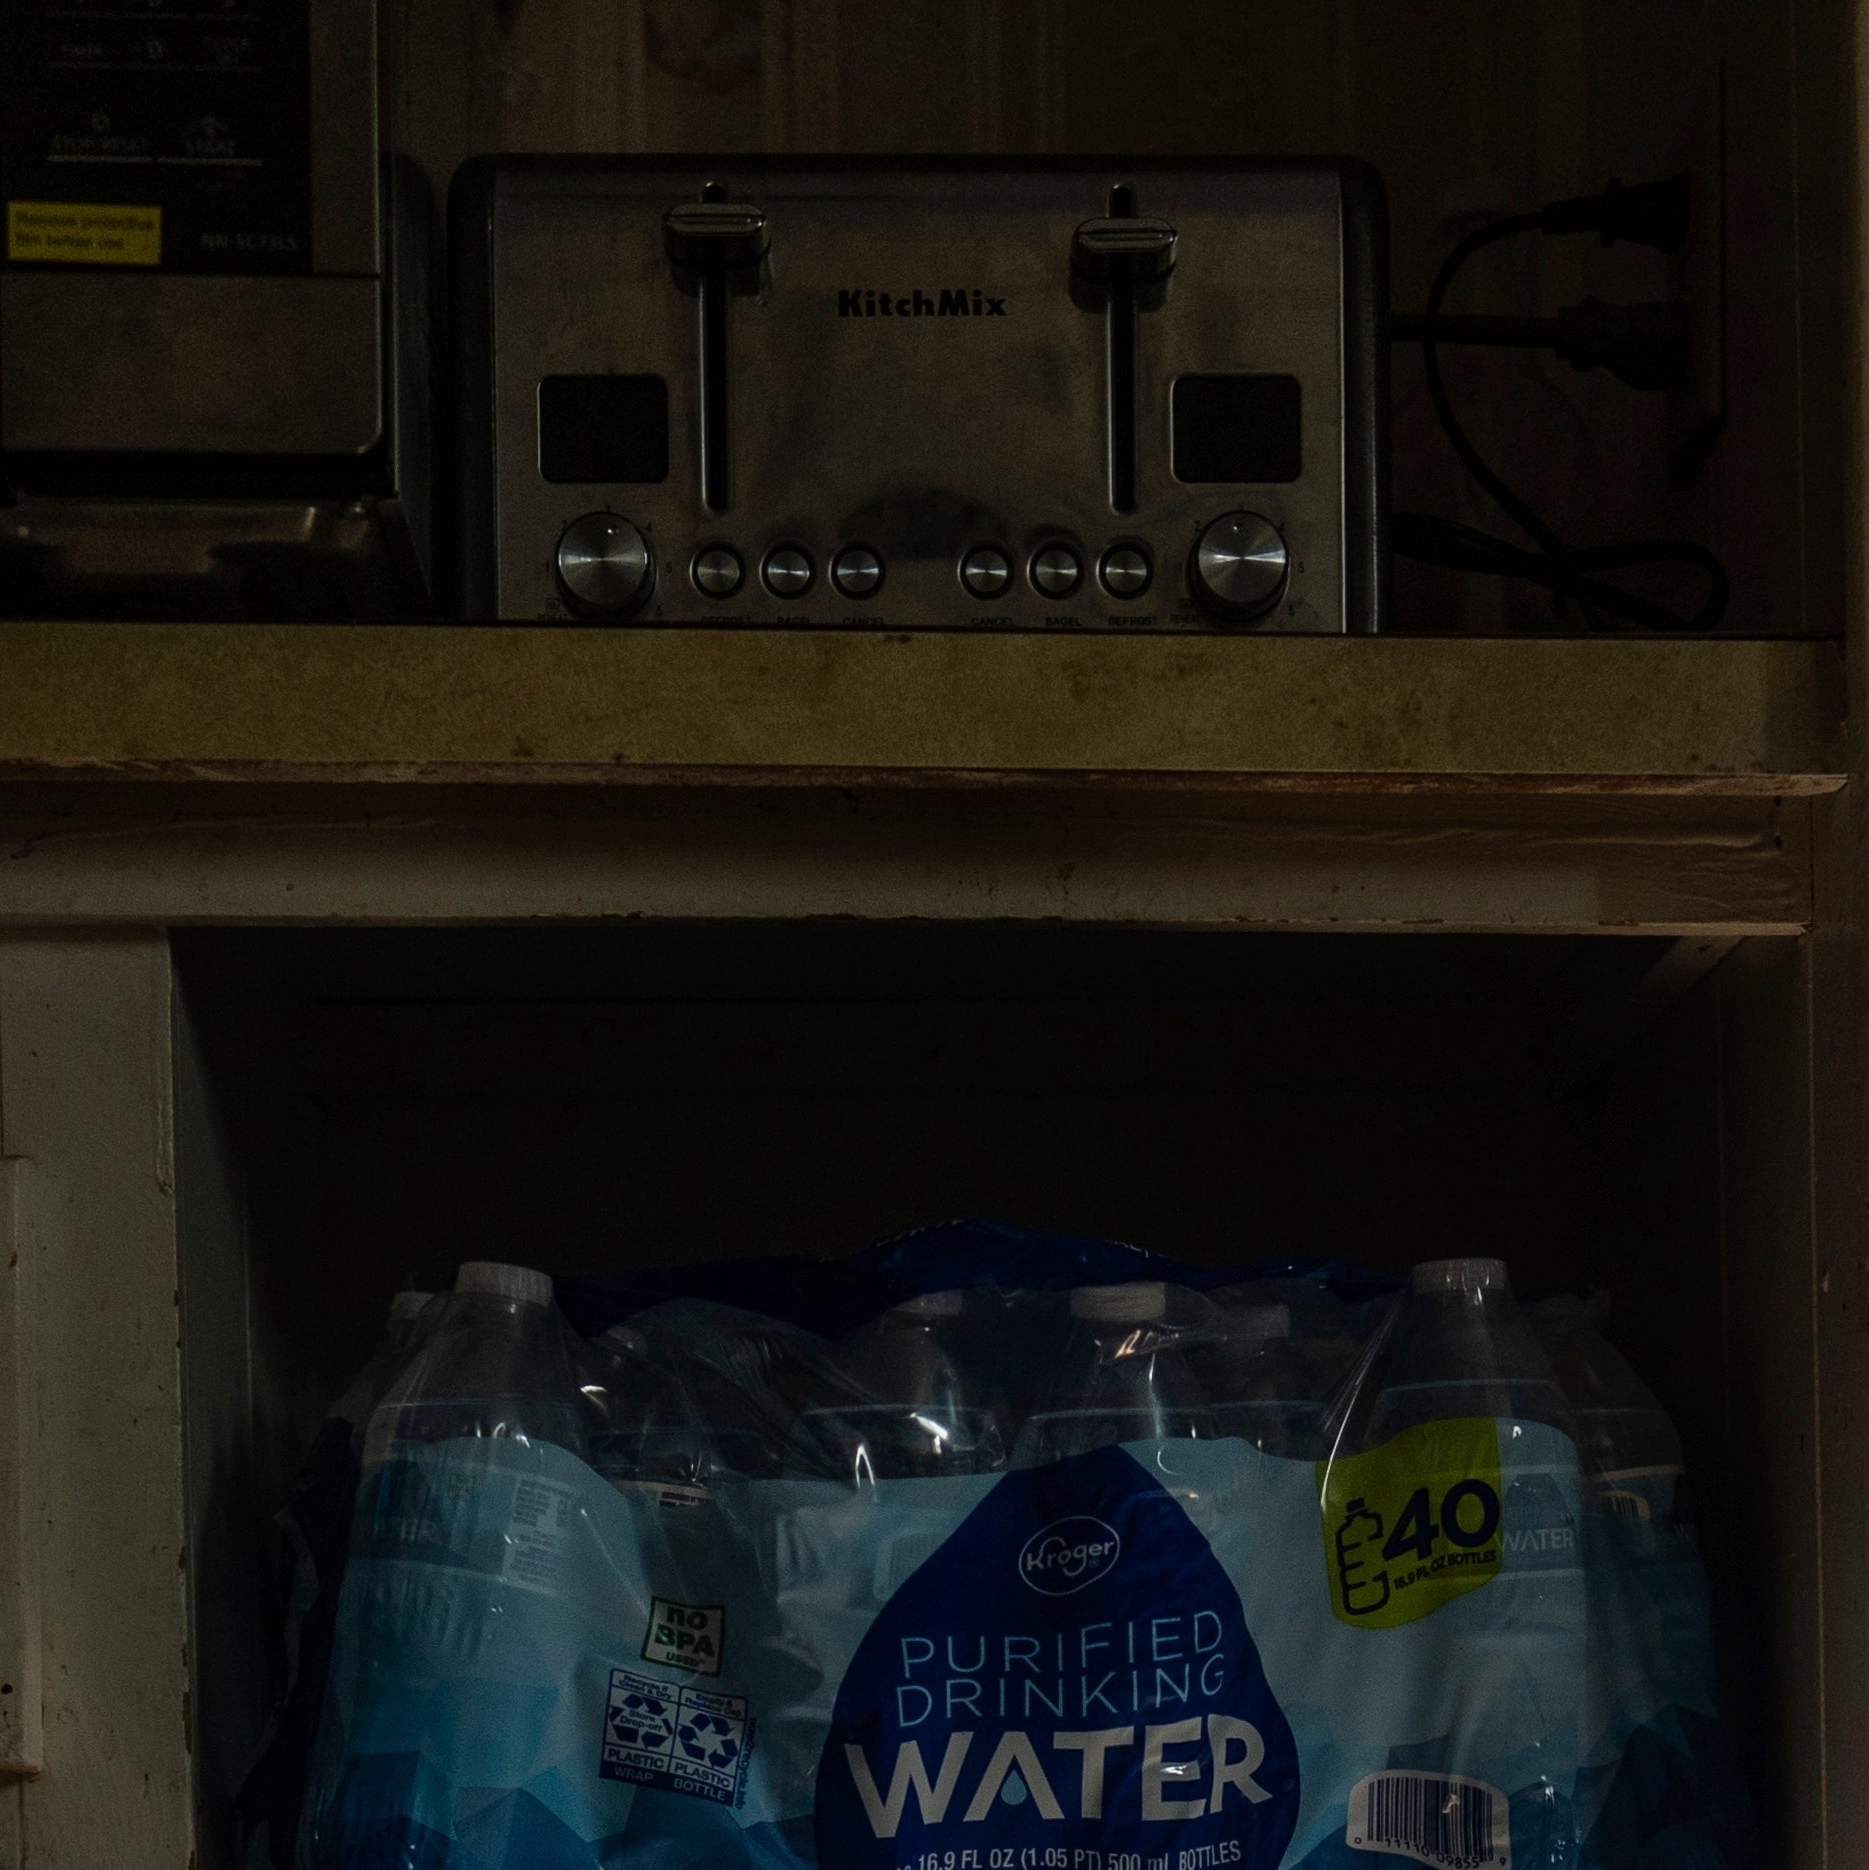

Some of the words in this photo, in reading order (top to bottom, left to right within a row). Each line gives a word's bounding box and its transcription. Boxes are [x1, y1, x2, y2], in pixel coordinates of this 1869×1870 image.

[838, 290, 1007, 317] KitchMix
[971, 618, 1014, 627] CANCEL
[1045, 617, 1081, 627] BAGEL
[1108, 617, 1158, 627] DEFROST
[1382, 1478, 1500, 1561] 40
[1501, 1528, 1576, 1552] WATER
[1026, 1536, 1115, 1578] Kroger
[1393, 1571, 1417, 1591] 16.9
[1416, 1566, 1429, 1584] FL
[1430, 1557, 1446, 1575] OZ
[1446, 1550, 1497, 1568] BOTTLES
[667, 1607, 708, 1630] no
[655, 1624, 715, 1656] BPA
[900, 1610, 1223, 1679] PURIFIED
[666, 1652, 699, 1668] USED
[619, 1680, 646, 1693] Clean
[656, 1690, 672, 1701] Dry
[624, 1675, 659, 1690] Recycle
[896, 1653, 1225, 1728] DRINKING
[629, 1710, 655, 1723] Store
[723, 1706, 741, 1717] Cap
[620, 1715, 662, 1732] Drop-off
[608, 1749, 664, 1769] PLASTIC
[614, 1763, 654, 1781] WRAP
[674, 1763, 730, 1788] PLASTIC
[843, 1713, 1274, 1839] WATER
[673, 1777, 726, 1800] BOTTLE
[961, 1849, 982, 1870] FL
[990, 1848, 1014, 1869] OZ
[1386, 1838, 1430, 1857] 11110
[1436, 1852, 1479, 1869] 09855
[1499, 1857, 1506, 1866] 9
